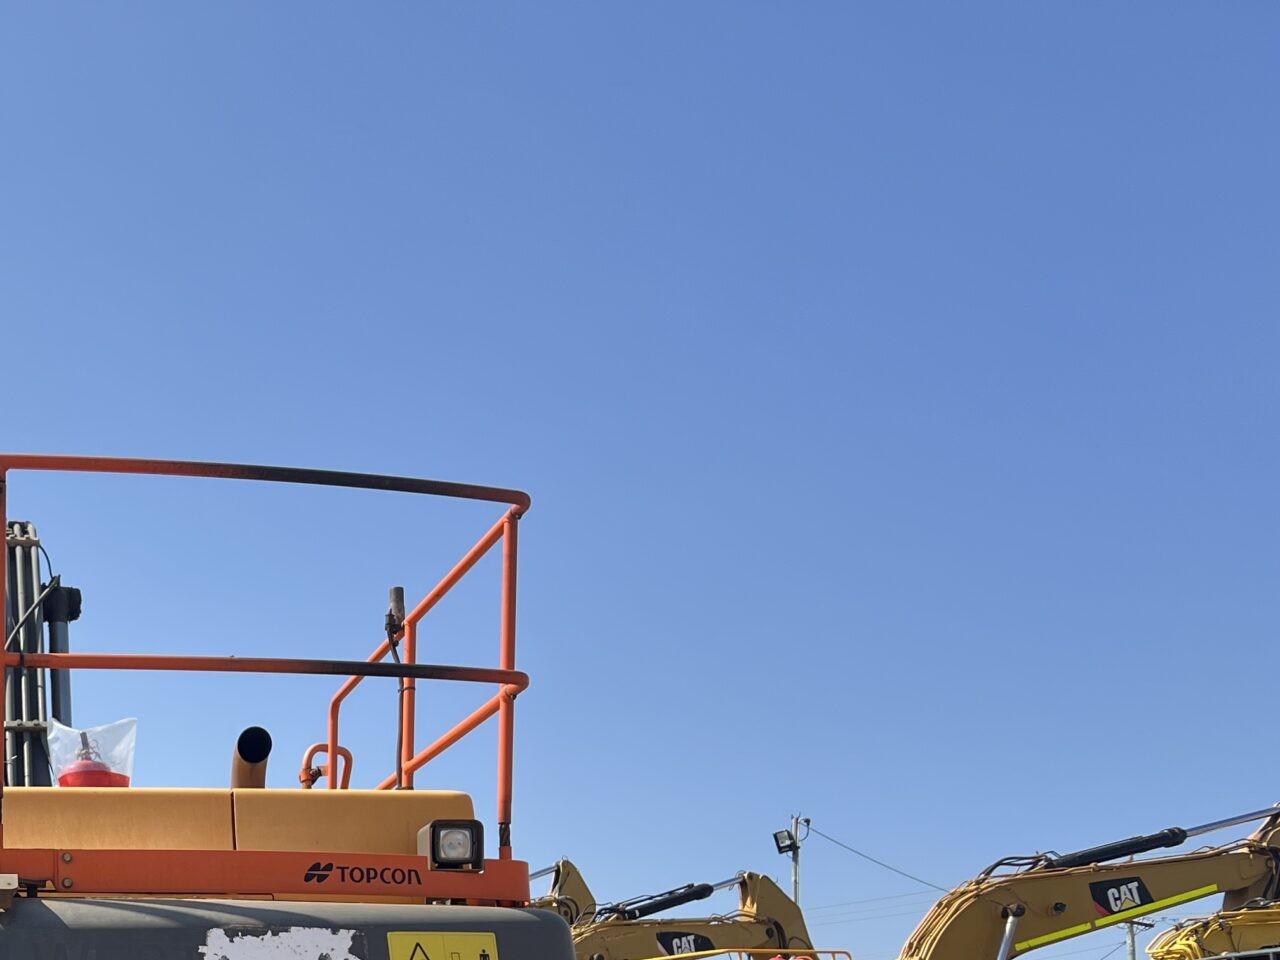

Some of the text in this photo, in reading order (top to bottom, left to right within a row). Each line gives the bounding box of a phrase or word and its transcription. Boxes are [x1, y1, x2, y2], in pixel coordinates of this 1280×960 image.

[336, 866, 423, 885] TOPCON
[1107, 881, 1141, 912] CAT
[672, 935, 696, 954] CAT
